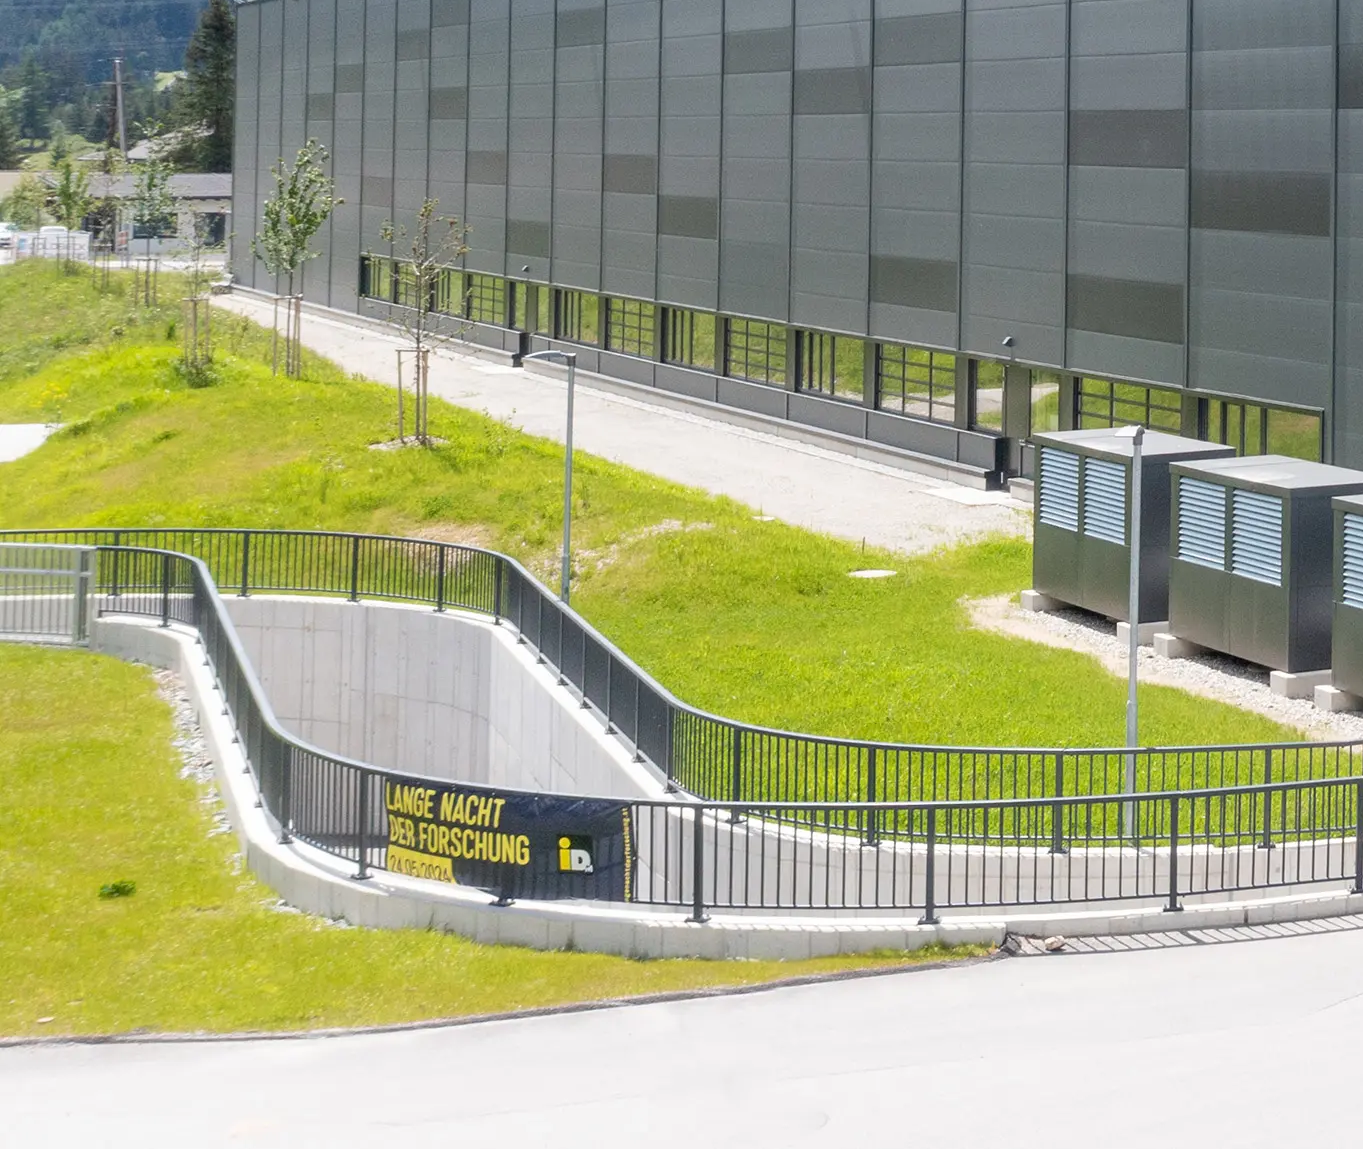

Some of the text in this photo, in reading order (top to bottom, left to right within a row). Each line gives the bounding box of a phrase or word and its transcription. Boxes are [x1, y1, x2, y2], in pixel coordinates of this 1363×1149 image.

[386, 781, 506, 828] LANGE NACHT
[389, 814, 530, 866] DER FORSCHUNG
